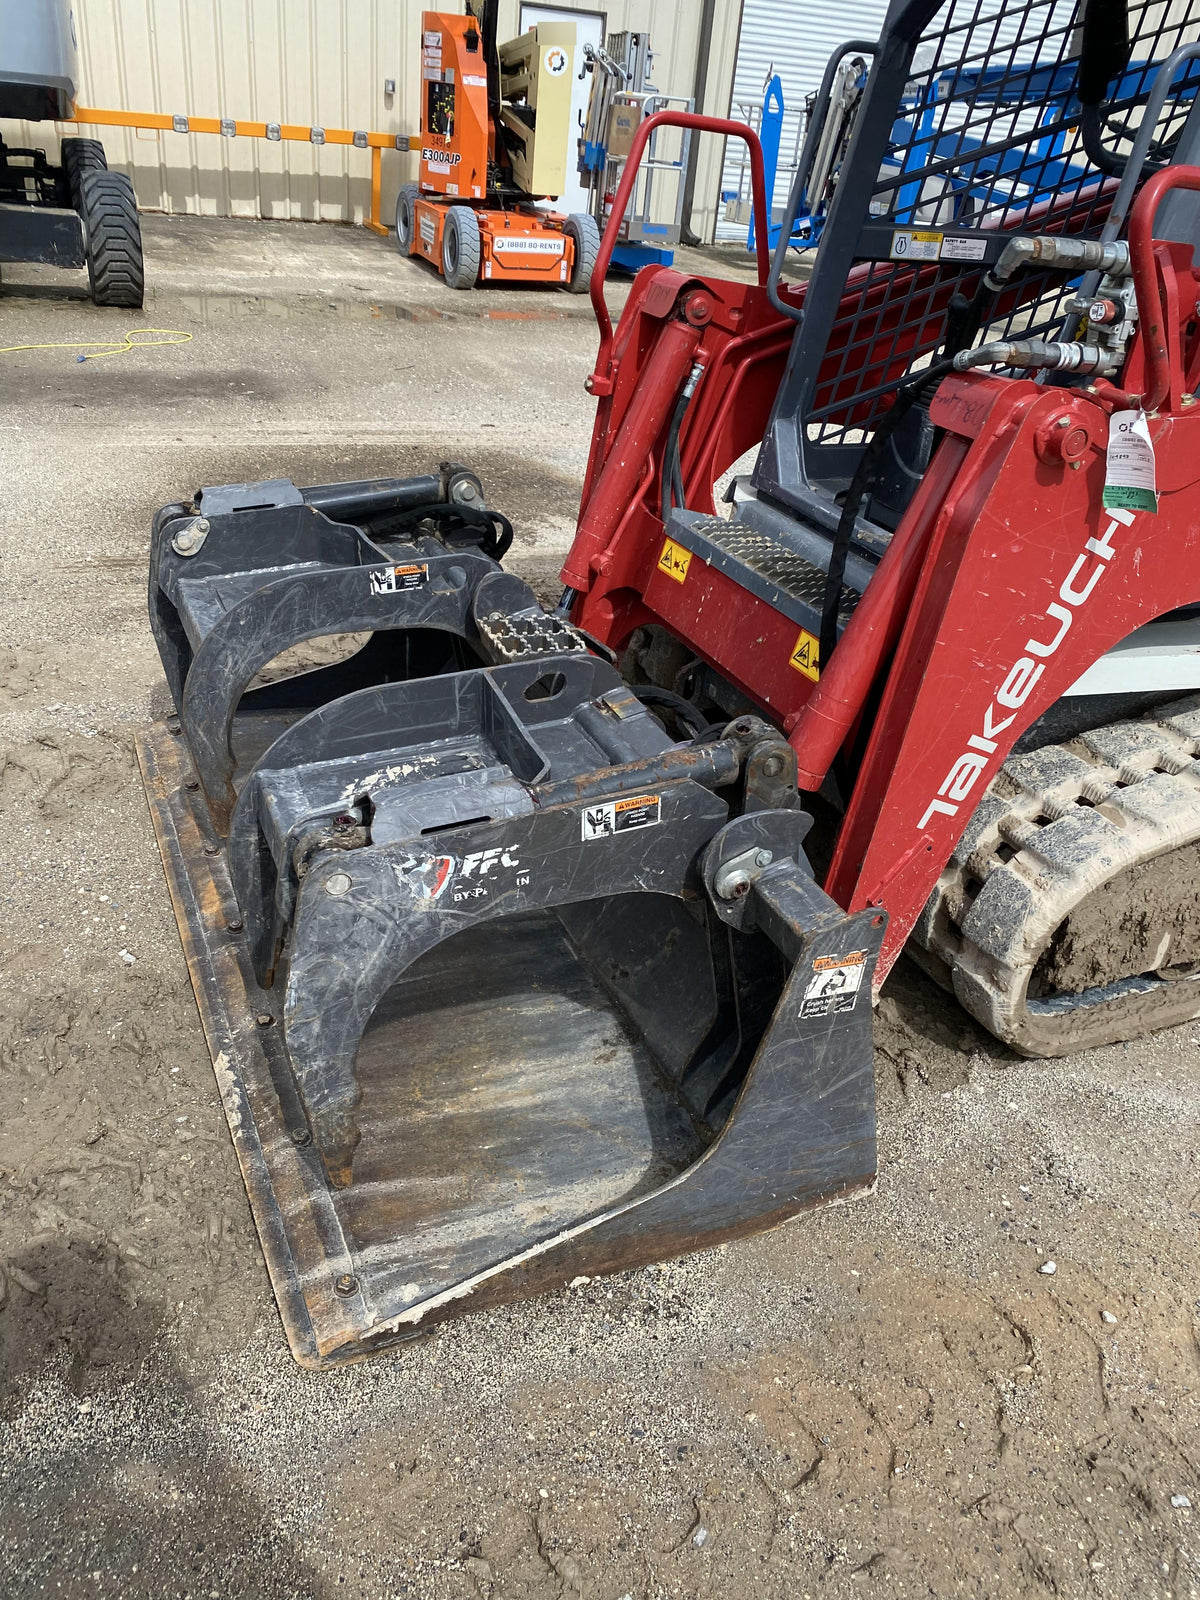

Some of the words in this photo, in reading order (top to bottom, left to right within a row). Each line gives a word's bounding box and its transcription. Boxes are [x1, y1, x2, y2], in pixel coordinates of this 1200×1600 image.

[422, 148, 461, 166] E300AJP
[507, 241, 527, 249] (888)
[528, 242, 561, 250] 80-RENTS
[916, 507, 1137, 830] TAKEUCH
[624, 797, 656, 808] WARNING
[461, 845, 519, 877] FFC
